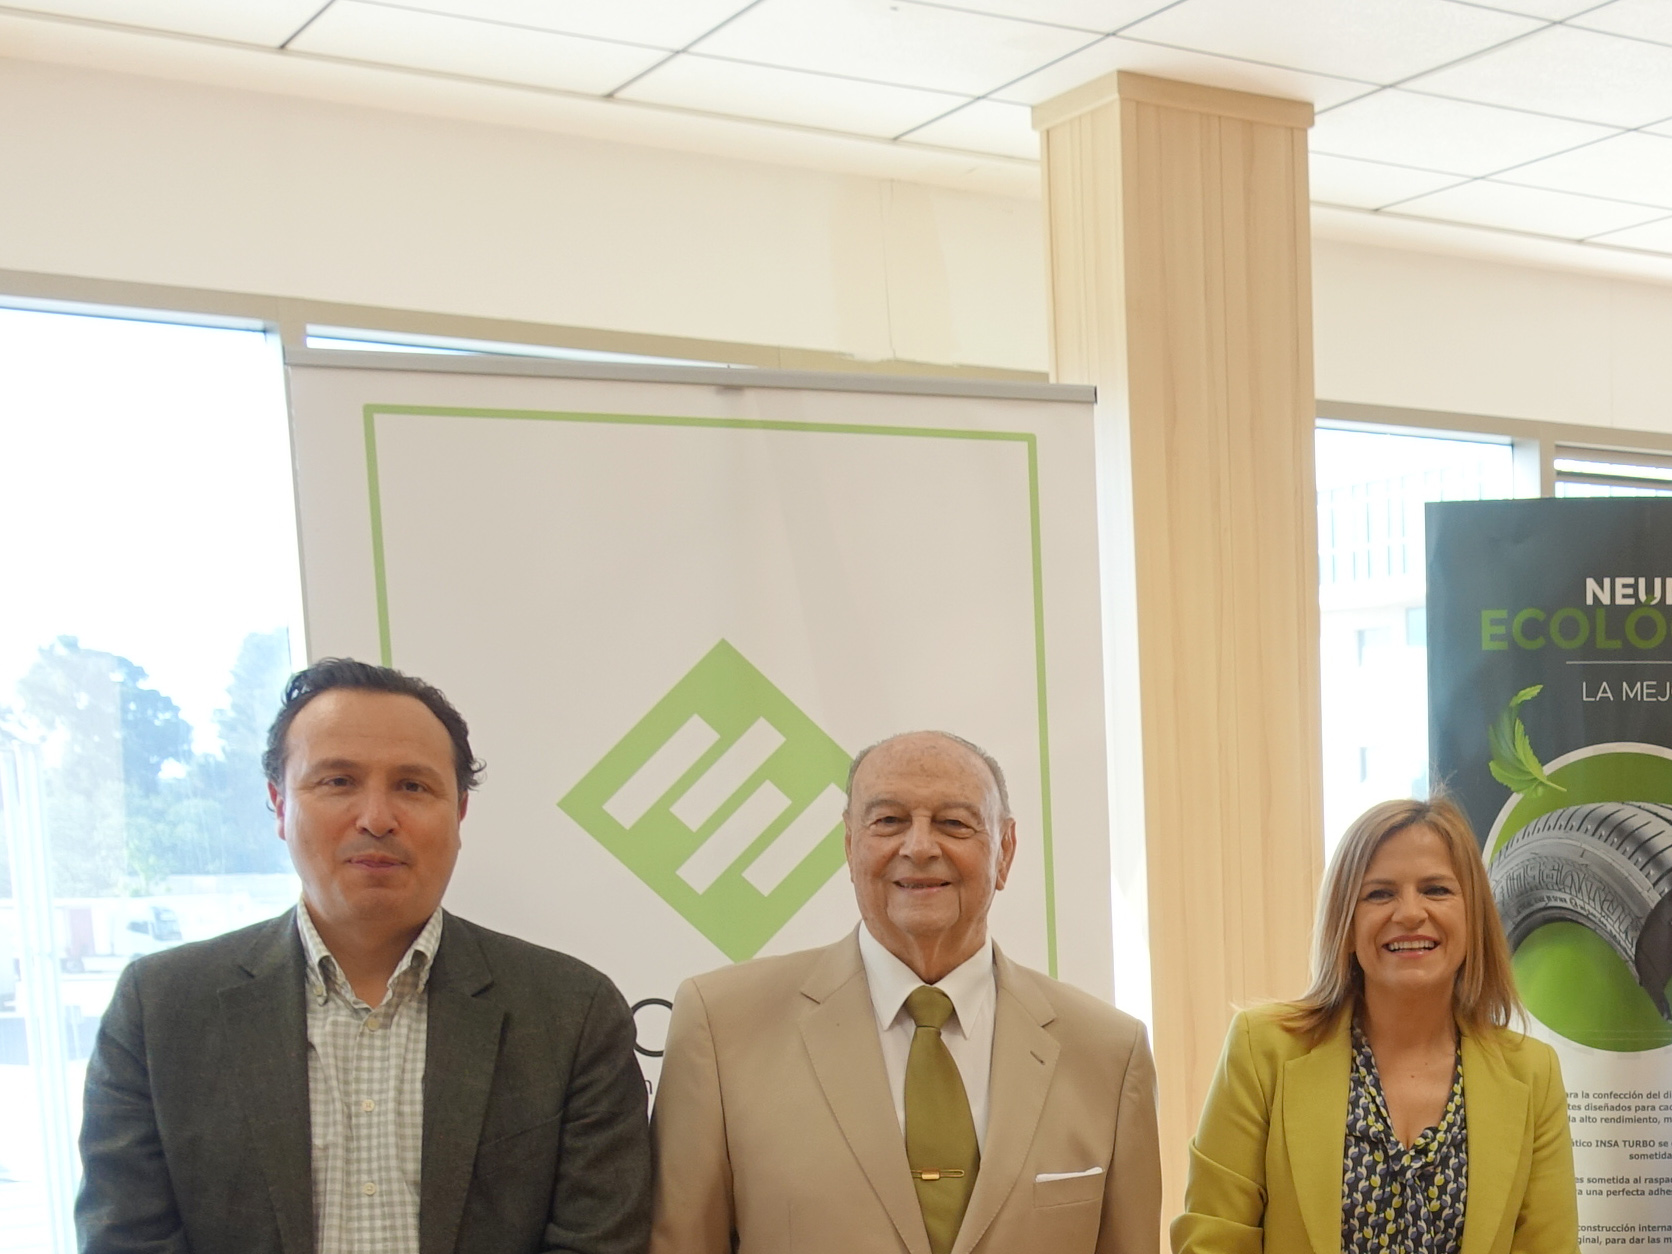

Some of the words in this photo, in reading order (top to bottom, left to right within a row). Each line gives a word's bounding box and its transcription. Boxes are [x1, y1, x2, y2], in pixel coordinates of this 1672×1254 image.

[1582, 681, 1614, 702] LA
[1581, 1090, 1590, 1099] la
[1592, 1090, 1644, 1100] confección
[1646, 1090, 1661, 1100] del
[1584, 1102, 1632, 1112] diseñados
[1634, 1104, 1656, 1114] para
[1579, 1114, 1597, 1123] alto
[1600, 1114, 1661, 1124] rendimiento,
[1595, 1140, 1620, 1148] INSA
[1622, 1139, 1656, 1148] TURBO
[1658, 1140, 1669, 1148] se
[1587, 1175, 1630, 1184] sometida
[1633, 1175, 1642, 1184] al
[1606, 1187, 1645, 1198] perfecta
[1638, 1223, 1672, 1232] interna
[1605, 1237, 1627, 1246] para
[1629, 1235, 1645, 1244] dar
[1647, 1235, 1661, 1244] las
